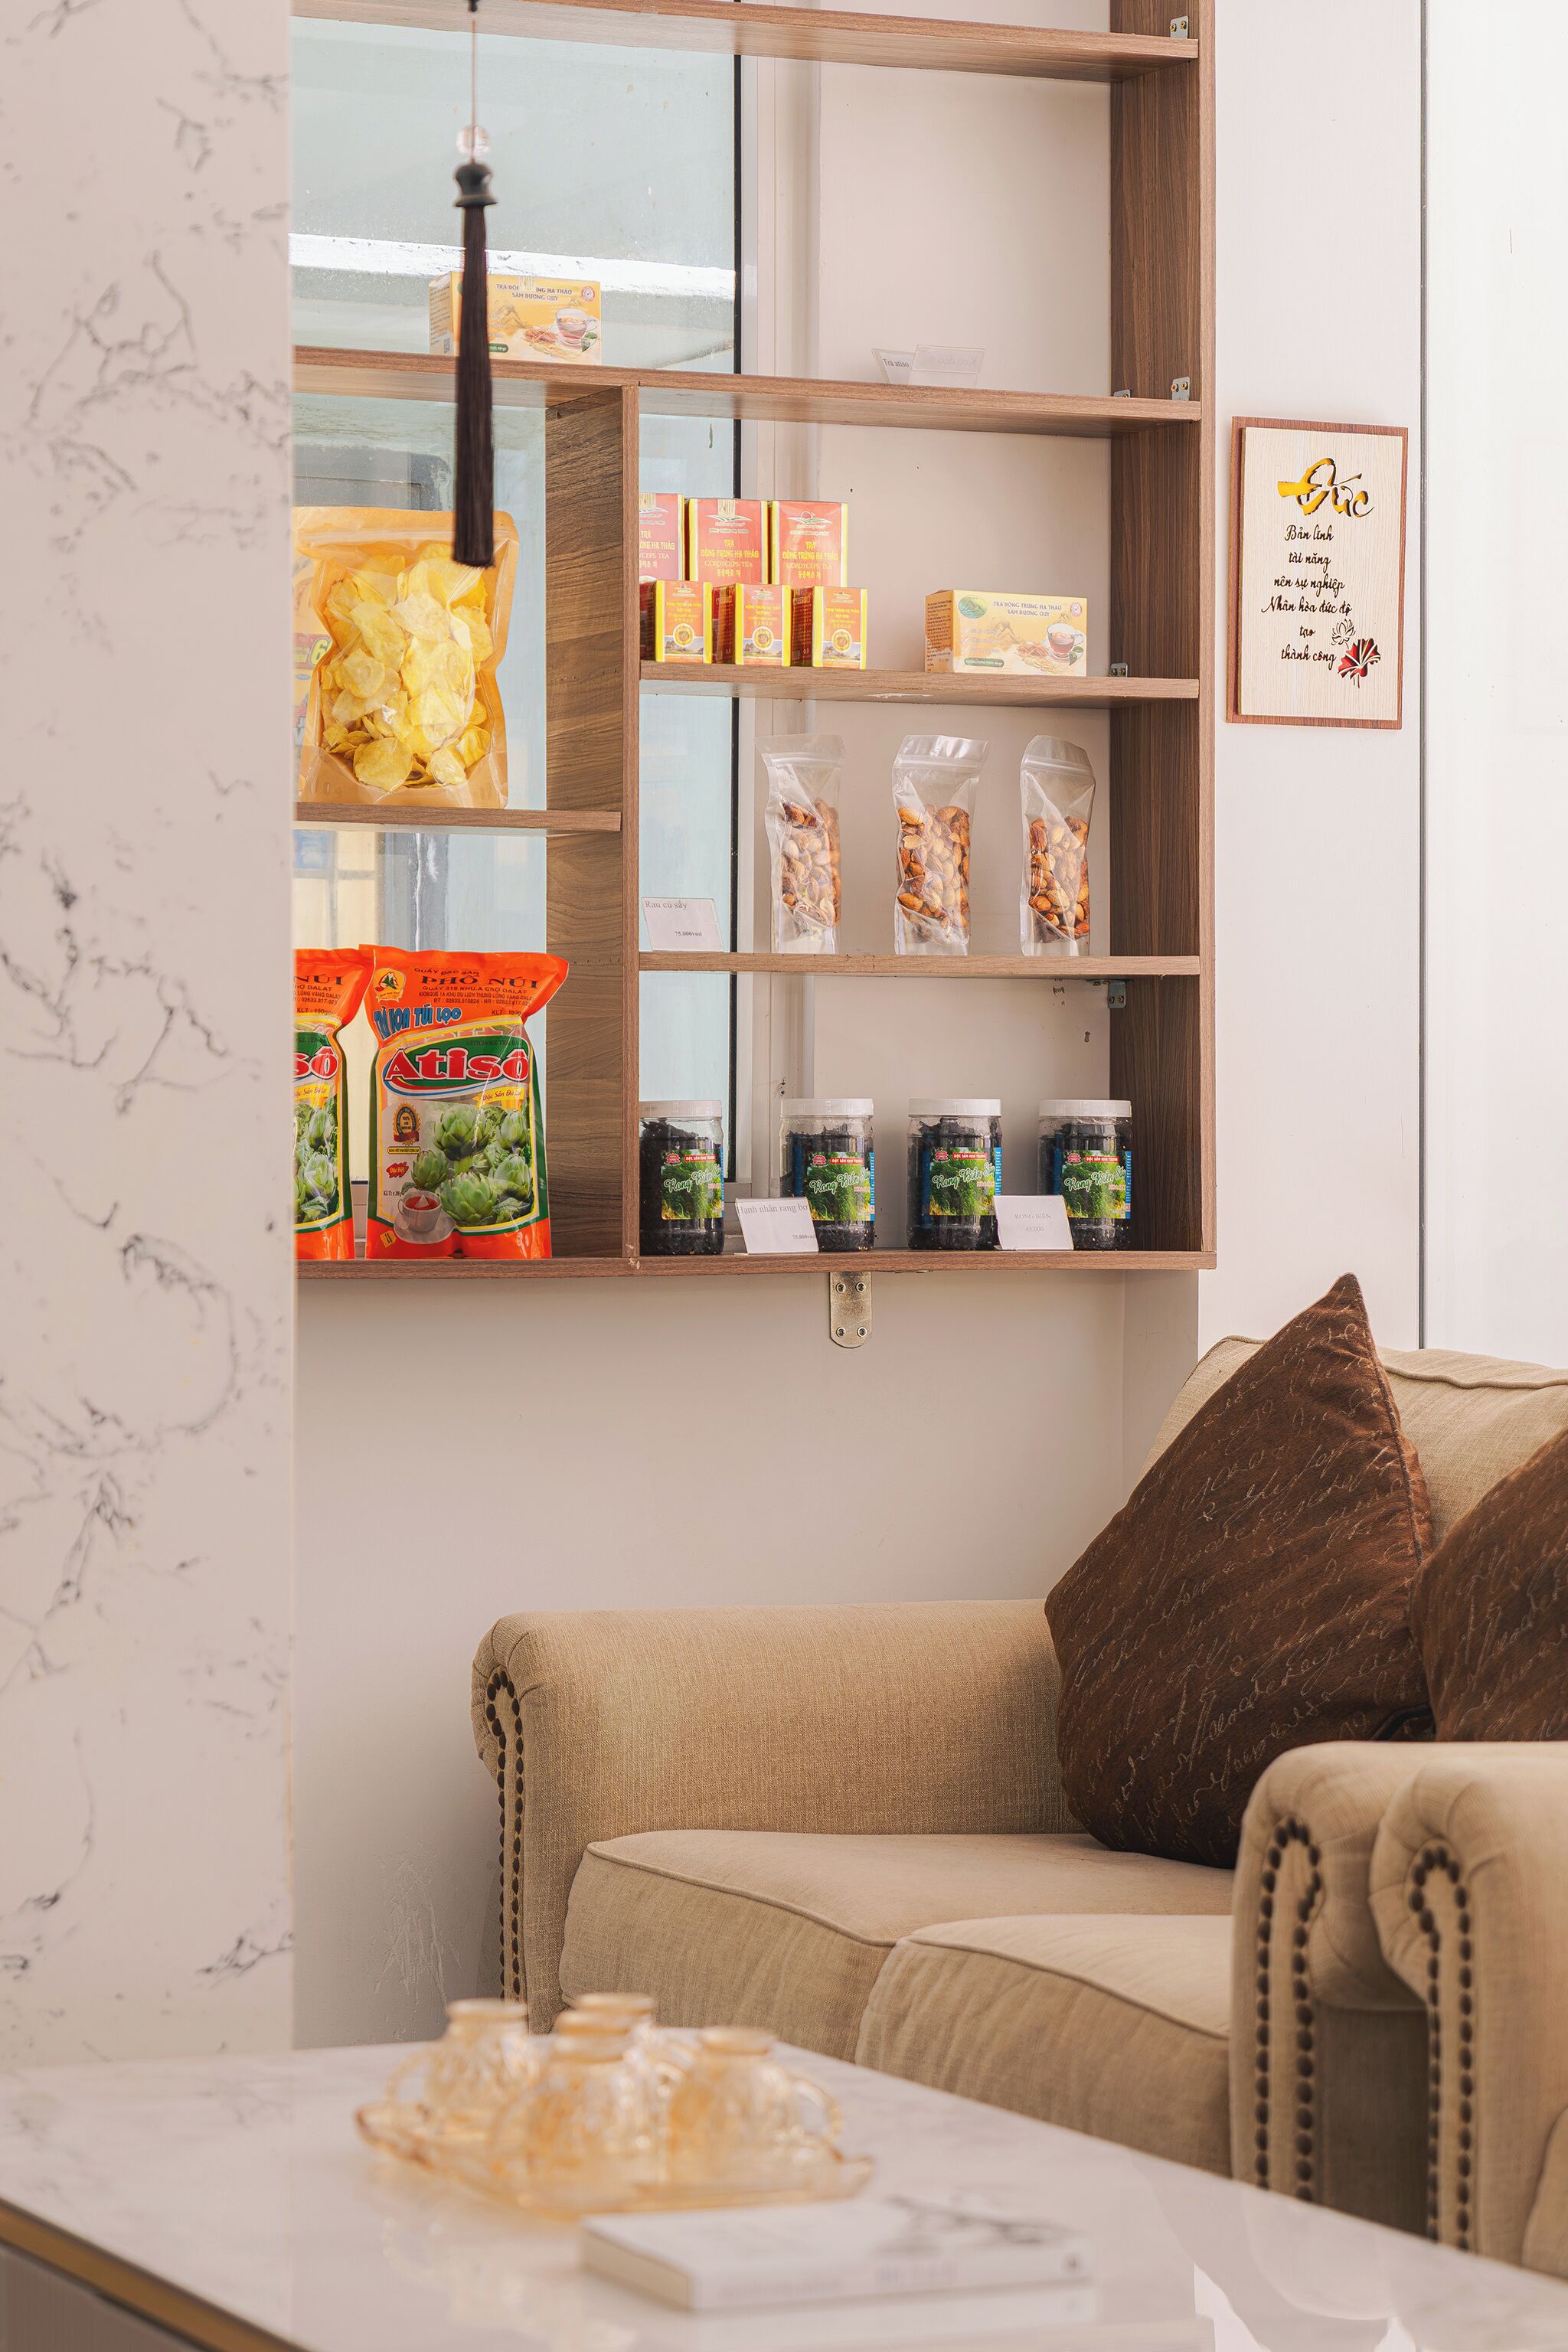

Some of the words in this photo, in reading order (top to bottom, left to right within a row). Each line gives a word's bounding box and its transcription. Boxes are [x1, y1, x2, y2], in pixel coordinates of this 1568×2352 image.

[1277, 457, 1374, 518] Đức
[1284, 524, 1311, 541] Bản
[1313, 524, 1334, 541] lĩnh
[1289, 552, 1303, 564] tài
[1305, 553, 1331, 573] năng
[1274, 576, 1293, 587] nên
[1295, 577, 1308, 590] sự
[1310, 573, 1345, 598] nghiệp
[1261, 595, 1296, 612] Nhân
[1298, 596, 1317, 612] hòa
[1318, 599, 1338, 614] đức
[1339, 600, 1352, 616] độ
[1299, 626, 1315, 638] tạo
[1281, 644, 1311, 660] thành
[1312, 651, 1337, 670] công
[645, 900, 661, 909] Rau
[487, 976, 539, 988] NÚI
[413, 1003, 433, 1027] TÚI
[436, 1007, 462, 1025] LỌC
[384, 1047, 529, 1082] Atisô
[664, 1178, 692, 1193] Rong
[691, 1168, 714, 1186] Biển
[809, 1179, 838, 1194] Rong
[837, 1171, 859, 1188] Biển
[932, 1174, 959, 1190] Rong
[959, 1166, 983, 1183] Biển
[1064, 1178, 1093, 1192] Rong
[1091, 1170, 1114, 1186] Biển
[737, 1206, 758, 1214] Hạnh
[760, 1205, 778, 1214] nhân
[779, 1204, 796, 1213] rang
